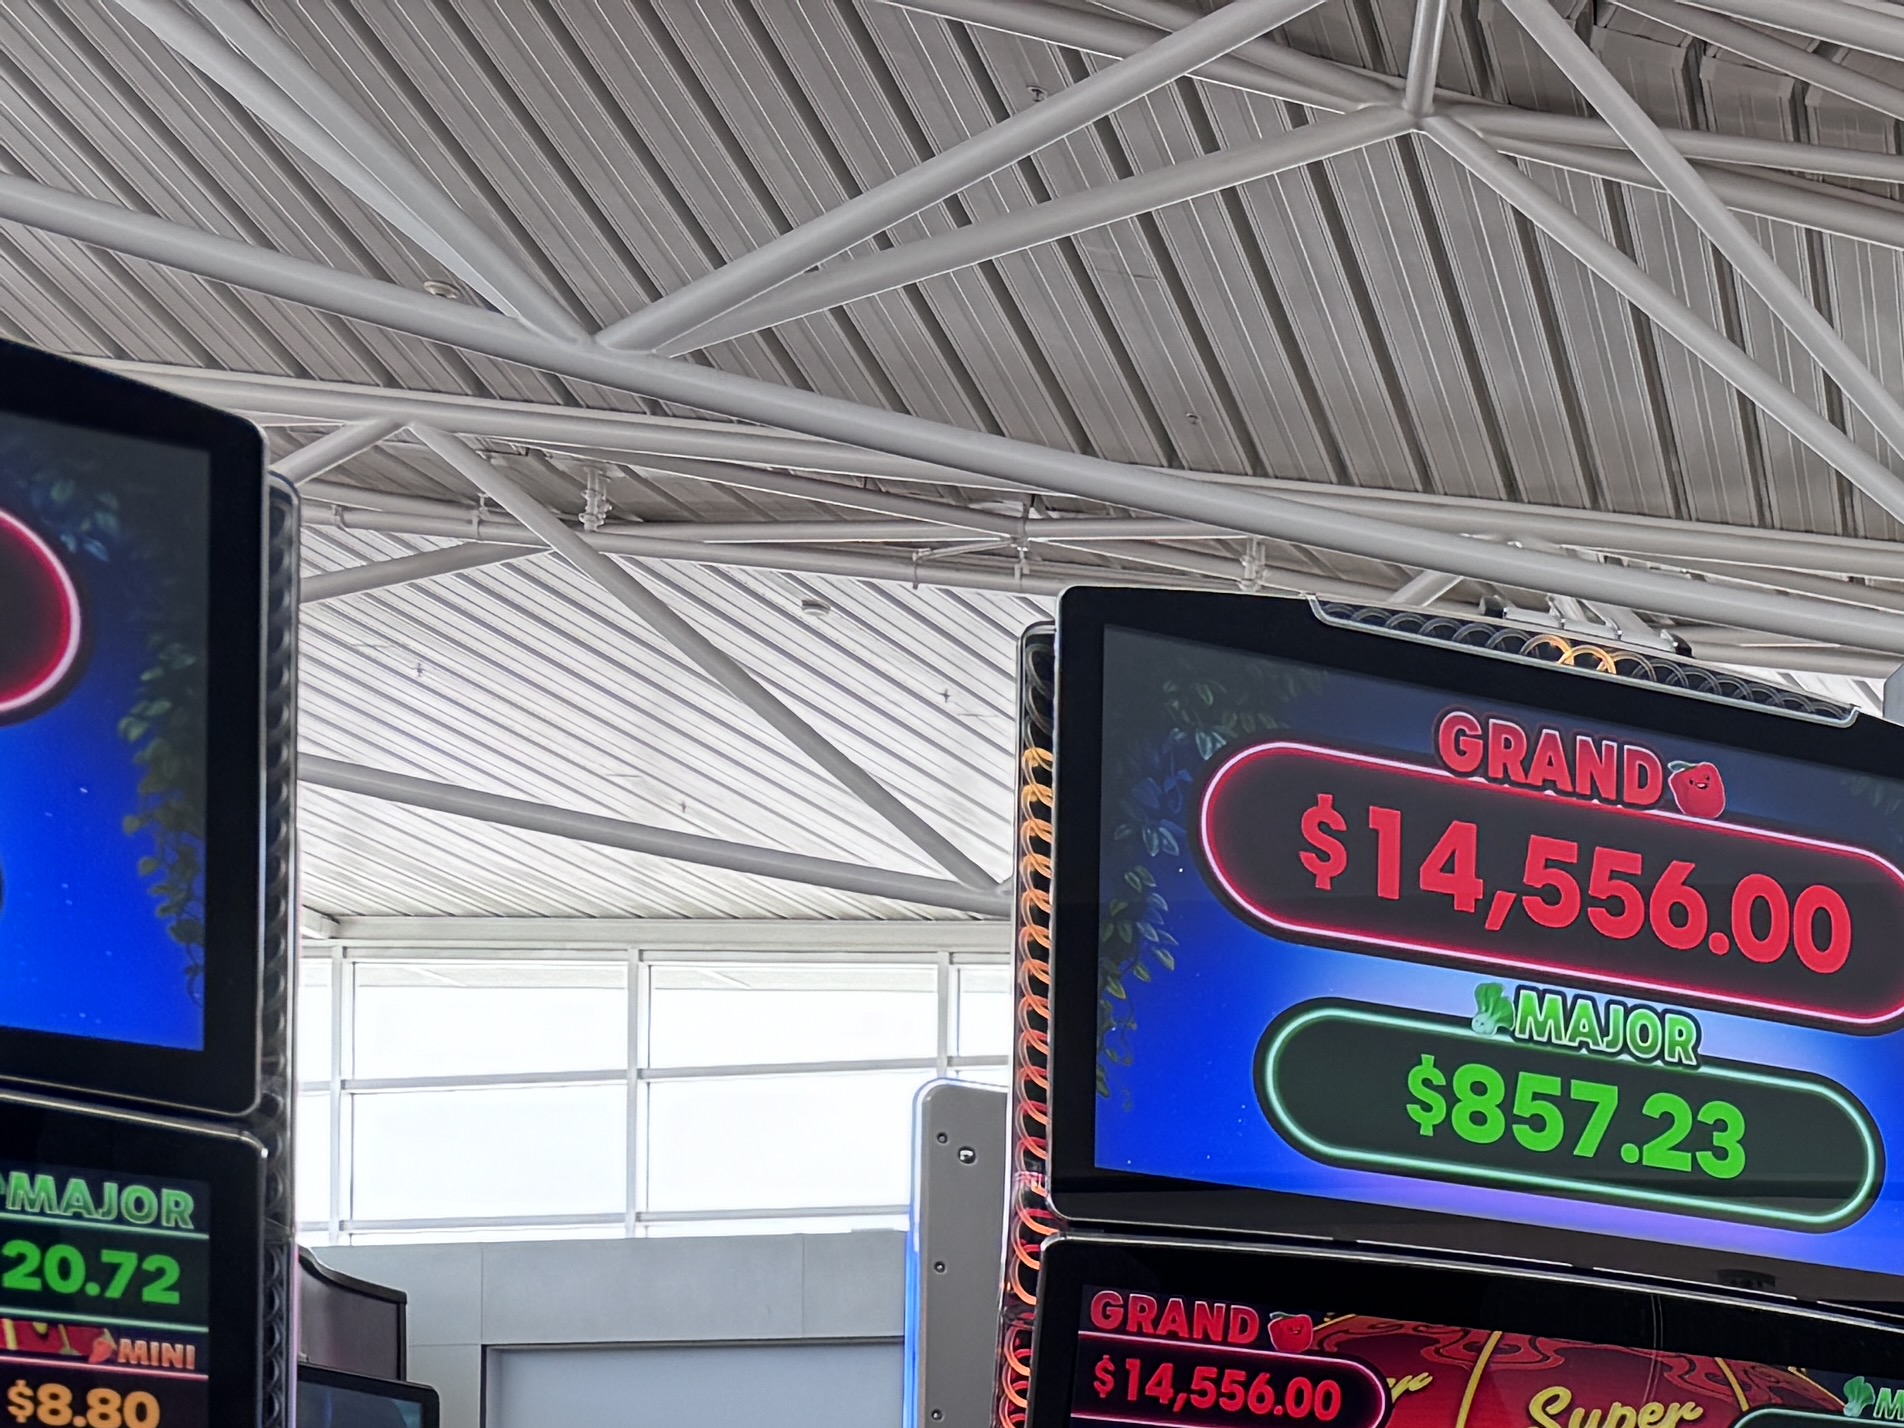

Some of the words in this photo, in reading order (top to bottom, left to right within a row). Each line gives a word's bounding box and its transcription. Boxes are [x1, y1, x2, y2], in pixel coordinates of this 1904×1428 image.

[1438, 710, 1664, 807] GRAND
[1298, 793, 1853, 975] $14,556.00
[1514, 985, 1699, 1067] MAJOR
[1405, 1054, 1747, 1180] $857.23
[6, 1171, 195, 1230] MAJOR
[1090, 1290, 1259, 1345] GRAND
[118, 1339, 196, 1370] MINI
[1094, 1355, 1342, 1420] $14,556.00
